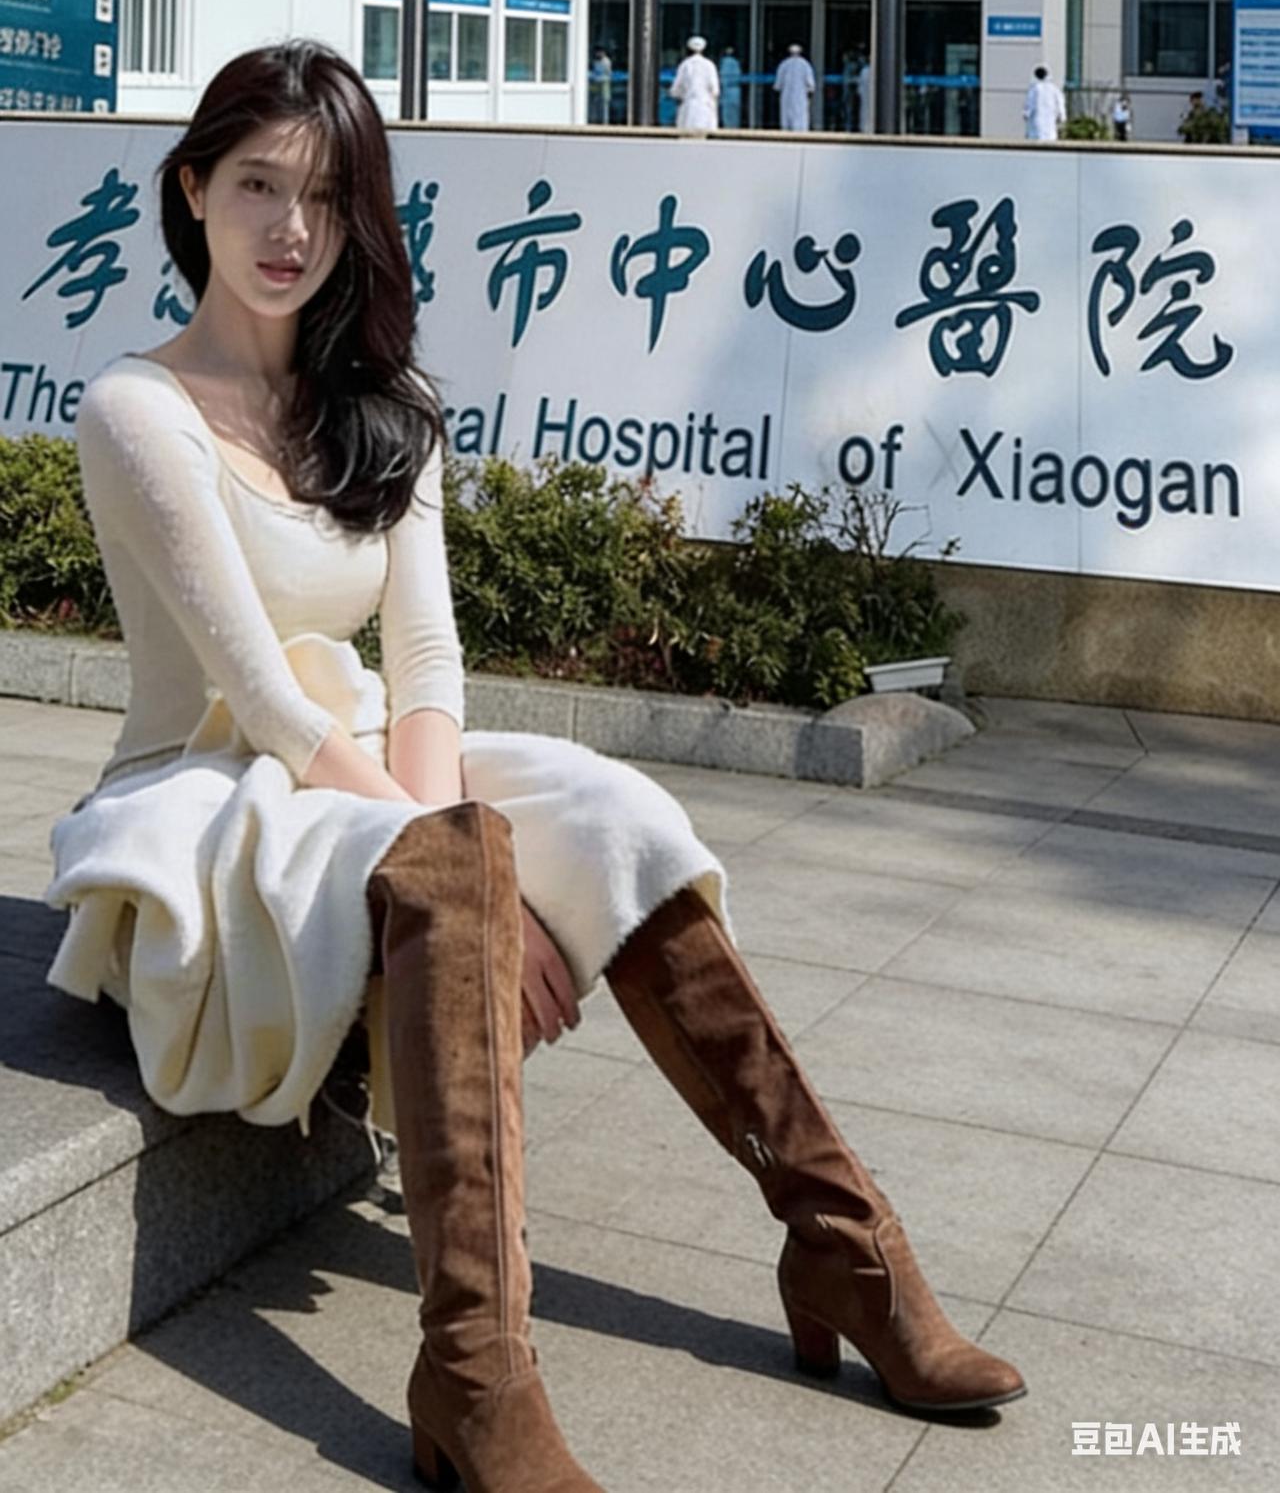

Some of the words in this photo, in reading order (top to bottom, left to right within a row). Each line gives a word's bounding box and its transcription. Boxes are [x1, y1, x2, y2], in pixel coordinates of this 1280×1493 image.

[22, 168, 1234, 380] 孝市中心醫院
[1, 362, 85, 424] The
[532, 396, 771, 481] Hospital
[838, 424, 903, 490] of
[956, 427, 1241, 530] Xiaogan
